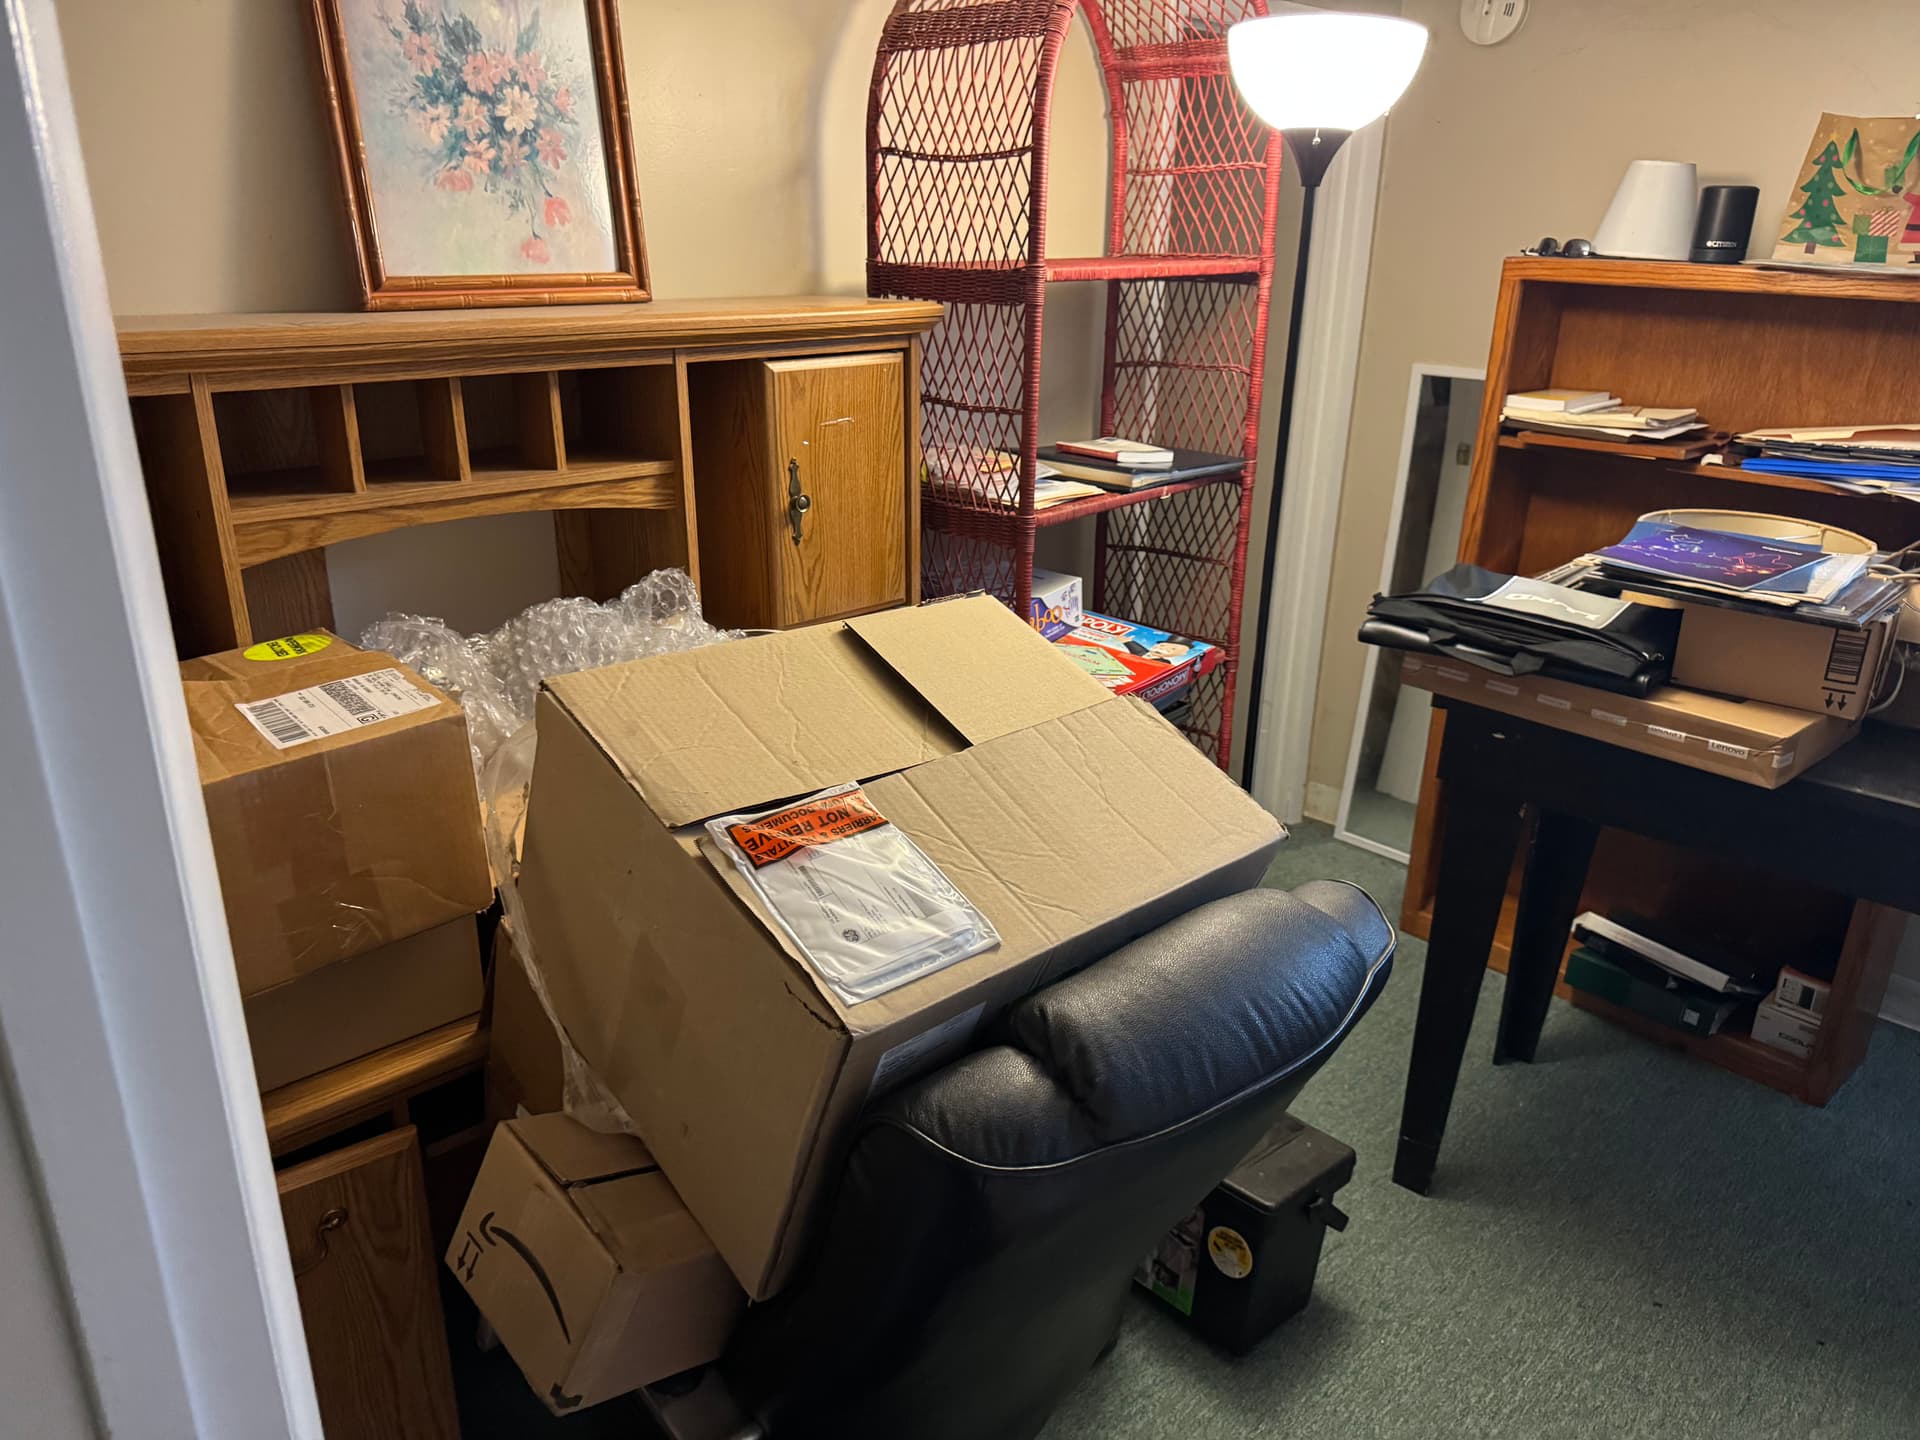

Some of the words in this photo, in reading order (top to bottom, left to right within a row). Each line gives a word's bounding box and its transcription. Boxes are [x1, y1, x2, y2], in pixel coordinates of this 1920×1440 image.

[1082, 616, 1130, 635] POLY
[1711, 742, 1745, 756] Lenovo
[818, 807, 850, 828] NOT
[831, 814, 882, 836] ARRIERS
[744, 821, 814, 852] REMVE
